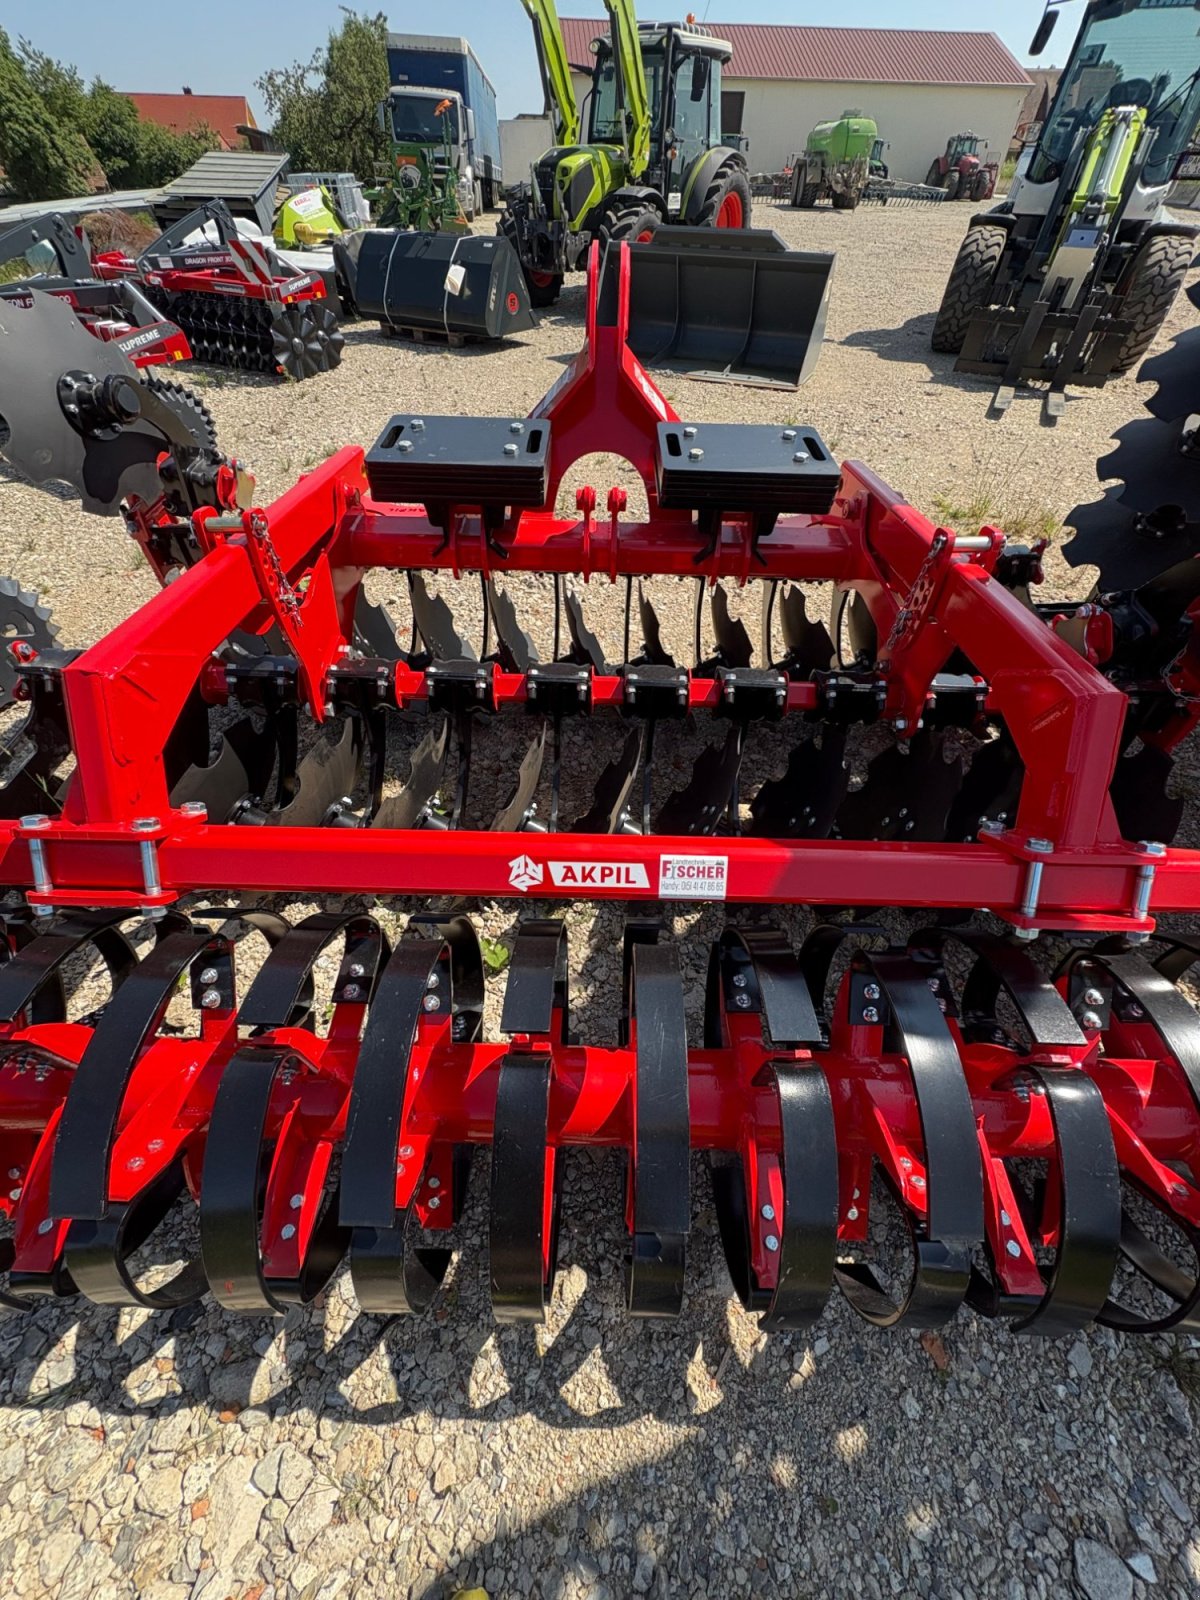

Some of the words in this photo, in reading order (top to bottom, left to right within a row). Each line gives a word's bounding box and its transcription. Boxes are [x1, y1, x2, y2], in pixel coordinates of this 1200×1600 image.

[184, 257, 206, 265] DRAGON
[207, 256, 224, 264] FRONT
[288, 276, 311, 292] SUPREME
[119, 328, 161, 353] SUPREME
[672, 857, 706, 866] Landtechnik
[561, 865, 637, 885] AKPIL
[661, 880, 680, 892] Handy:
